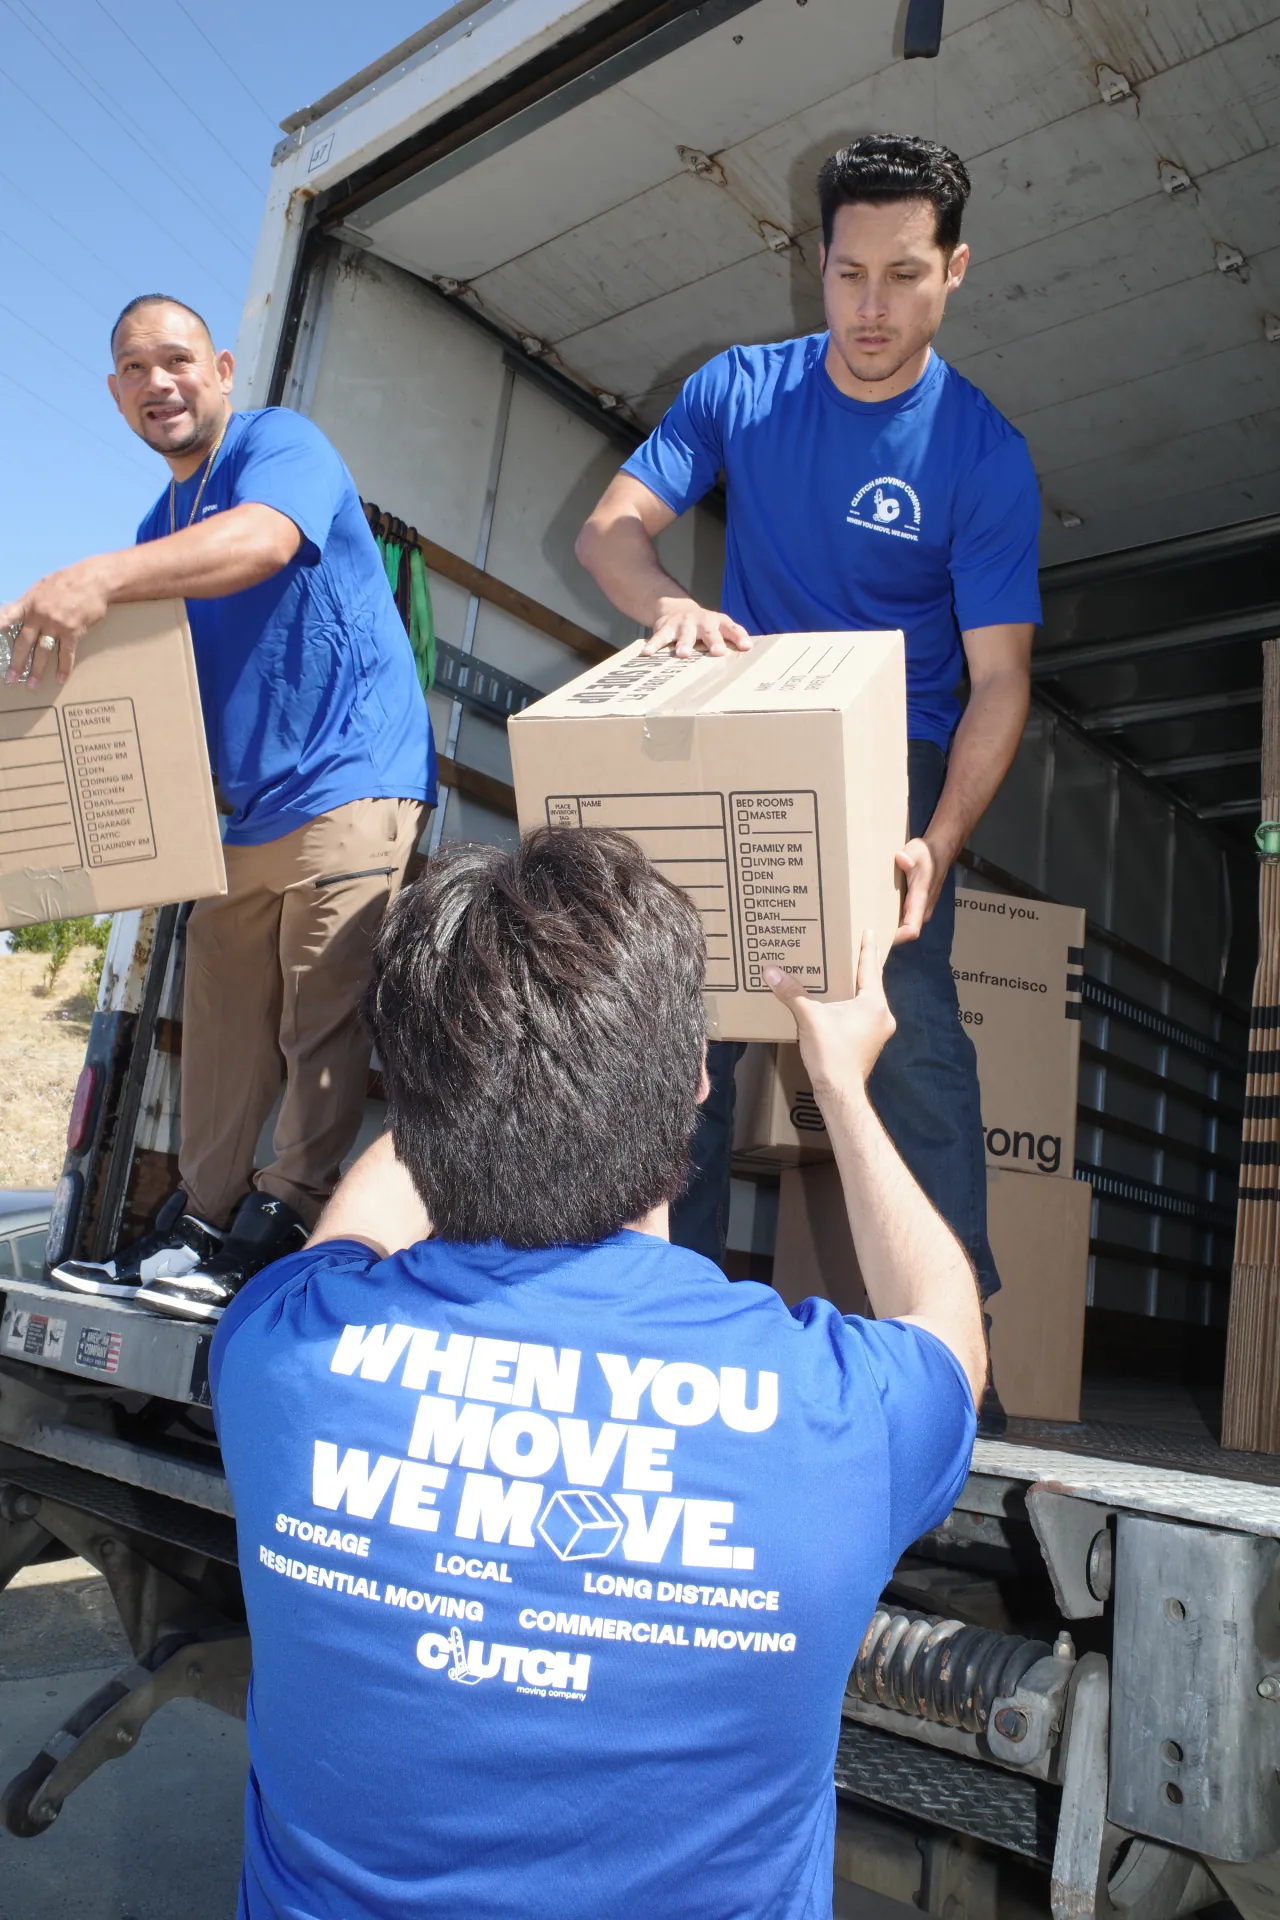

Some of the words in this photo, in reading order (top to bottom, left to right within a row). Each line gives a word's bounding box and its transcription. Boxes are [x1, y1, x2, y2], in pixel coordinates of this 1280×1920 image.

[850, 480, 875, 507] CLUTCH
[875, 476, 906, 489] MOVING
[904, 485, 921, 525] COMPANY
[846, 515, 863, 526] WHEN
[862, 521, 874, 530] YOU
[585, 670, 653, 689] SIDE
[566, 691, 620, 703] UP
[68, 708, 83, 717] BED
[85, 705, 115, 715] ROOMS
[81, 716, 111, 726] MASTER
[85, 743, 111, 752] FAMILY
[87, 754, 113, 763] LIVING
[115, 752, 127, 760] RM
[89, 766, 104, 775] DEN
[91, 775, 119, 785] DINING
[121, 774, 133, 782] RM
[92, 786, 125, 796] KITCHEN
[94, 799, 113, 808] BATH
[581, 800, 602, 808] NAME
[736, 798, 754, 808] BED
[757, 798, 794, 807] ROOMS
[96, 807, 135, 818] BASEMENT
[750, 810, 787, 820] MASTER
[98, 818, 131, 829] GARAGE
[100, 831, 120, 840] ATTIC
[101, 840, 135, 851] LAUNDRY
[138, 837, 150, 845] RM
[752, 843, 785, 853] FAMILY
[787, 843, 802, 853] RM
[753, 857, 786, 867] LIVING
[788, 857, 803, 867] RM
[754, 871, 774, 880] DEN
[755, 885, 790, 894] DINING
[793, 885, 808, 894] RM
[756, 899, 796, 908] KITCHEN
[955, 898, 1006, 915] around
[1009, 906, 1039, 920] you.
[757, 912, 780, 921] BATH
[758, 926, 807, 934] BASEMENT
[759, 939, 801, 947] GARAGE
[760, 952, 785, 960] ATTIC
[806, 966, 821, 974] RM
[983, 1126, 1062, 1173] ong
[330, 1323, 581, 1413] WHEN
[596, 1352, 779, 1433] YOU
[406, 1394, 676, 1492] MOVE
[312, 1439, 449, 1532] WE
[275, 1512, 371, 1558] STORAGE
[434, 1552, 512, 1584] LOCAL
[259, 1544, 381, 1602] RESIDENTIAL
[384, 1584, 484, 1622] MOVING
[584, 1572, 652, 1600] LONG
[656, 1581, 780, 1611] DISTANCE
[518, 1608, 689, 1646] COMMERCIAL
[693, 1627, 797, 1652] MOVING
[516, 1685, 547, 1698] moving
[548, 1690, 587, 1702] company
